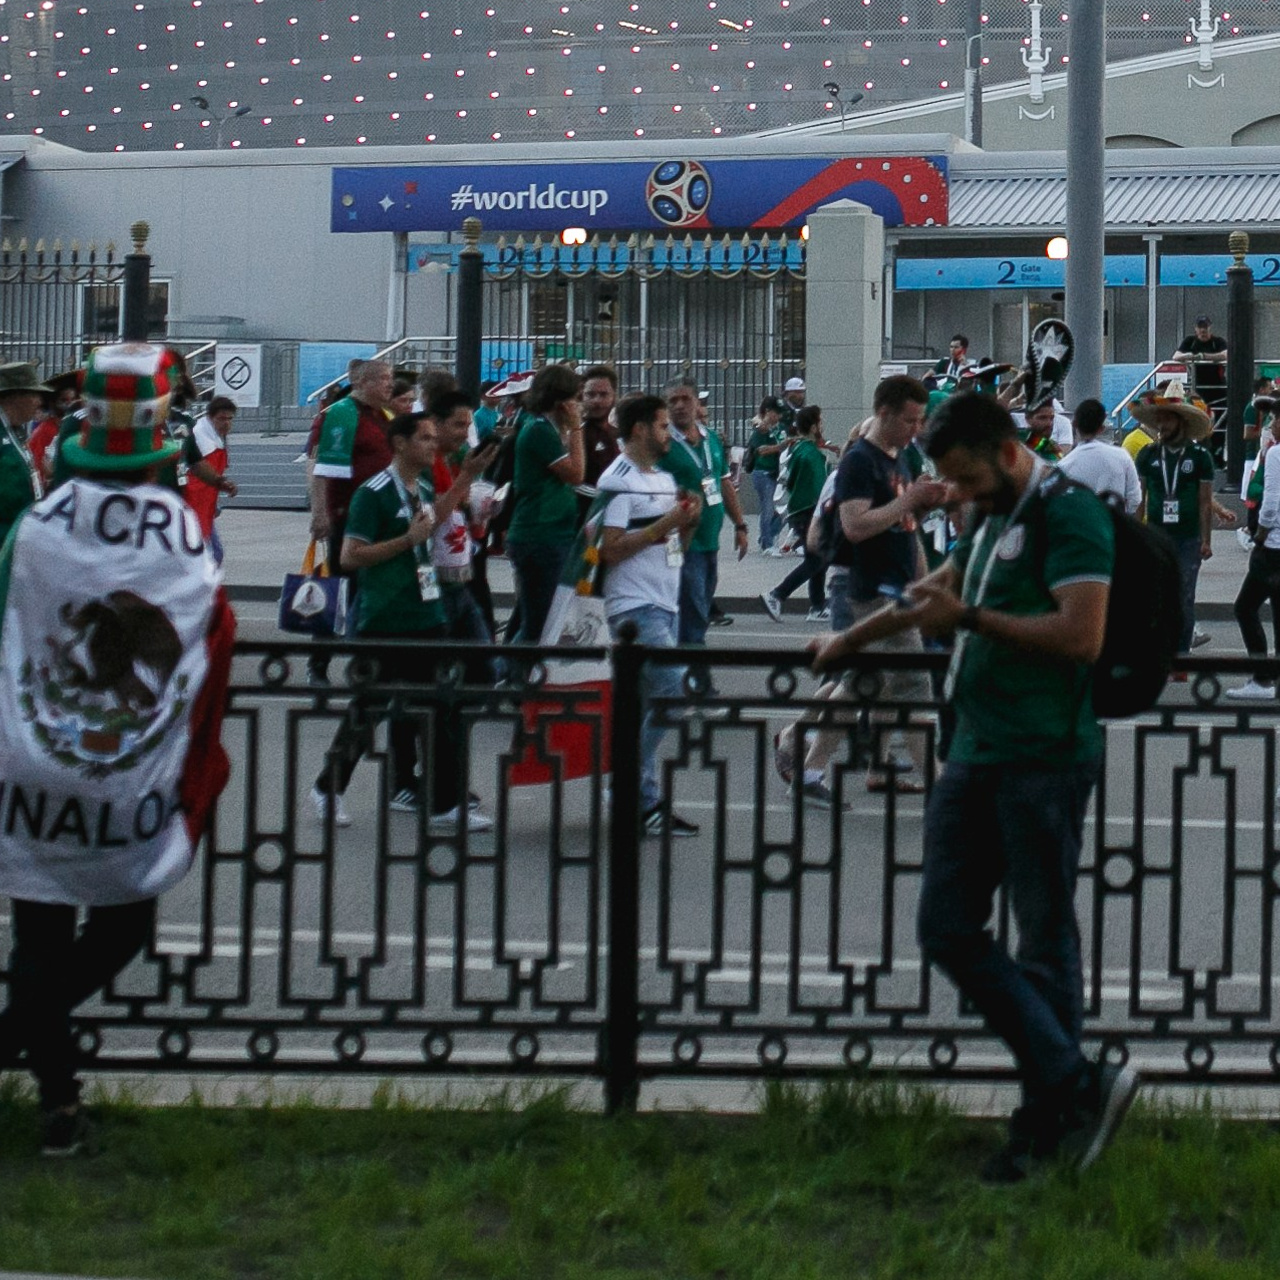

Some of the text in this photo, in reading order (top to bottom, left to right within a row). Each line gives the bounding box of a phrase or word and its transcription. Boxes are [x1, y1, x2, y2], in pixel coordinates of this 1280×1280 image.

[451, 183, 609, 216] #worldcup
[997, 261, 1016, 284] 2
[1021, 264, 1041, 272] Gate
[1263, 258, 1280, 281] 2
